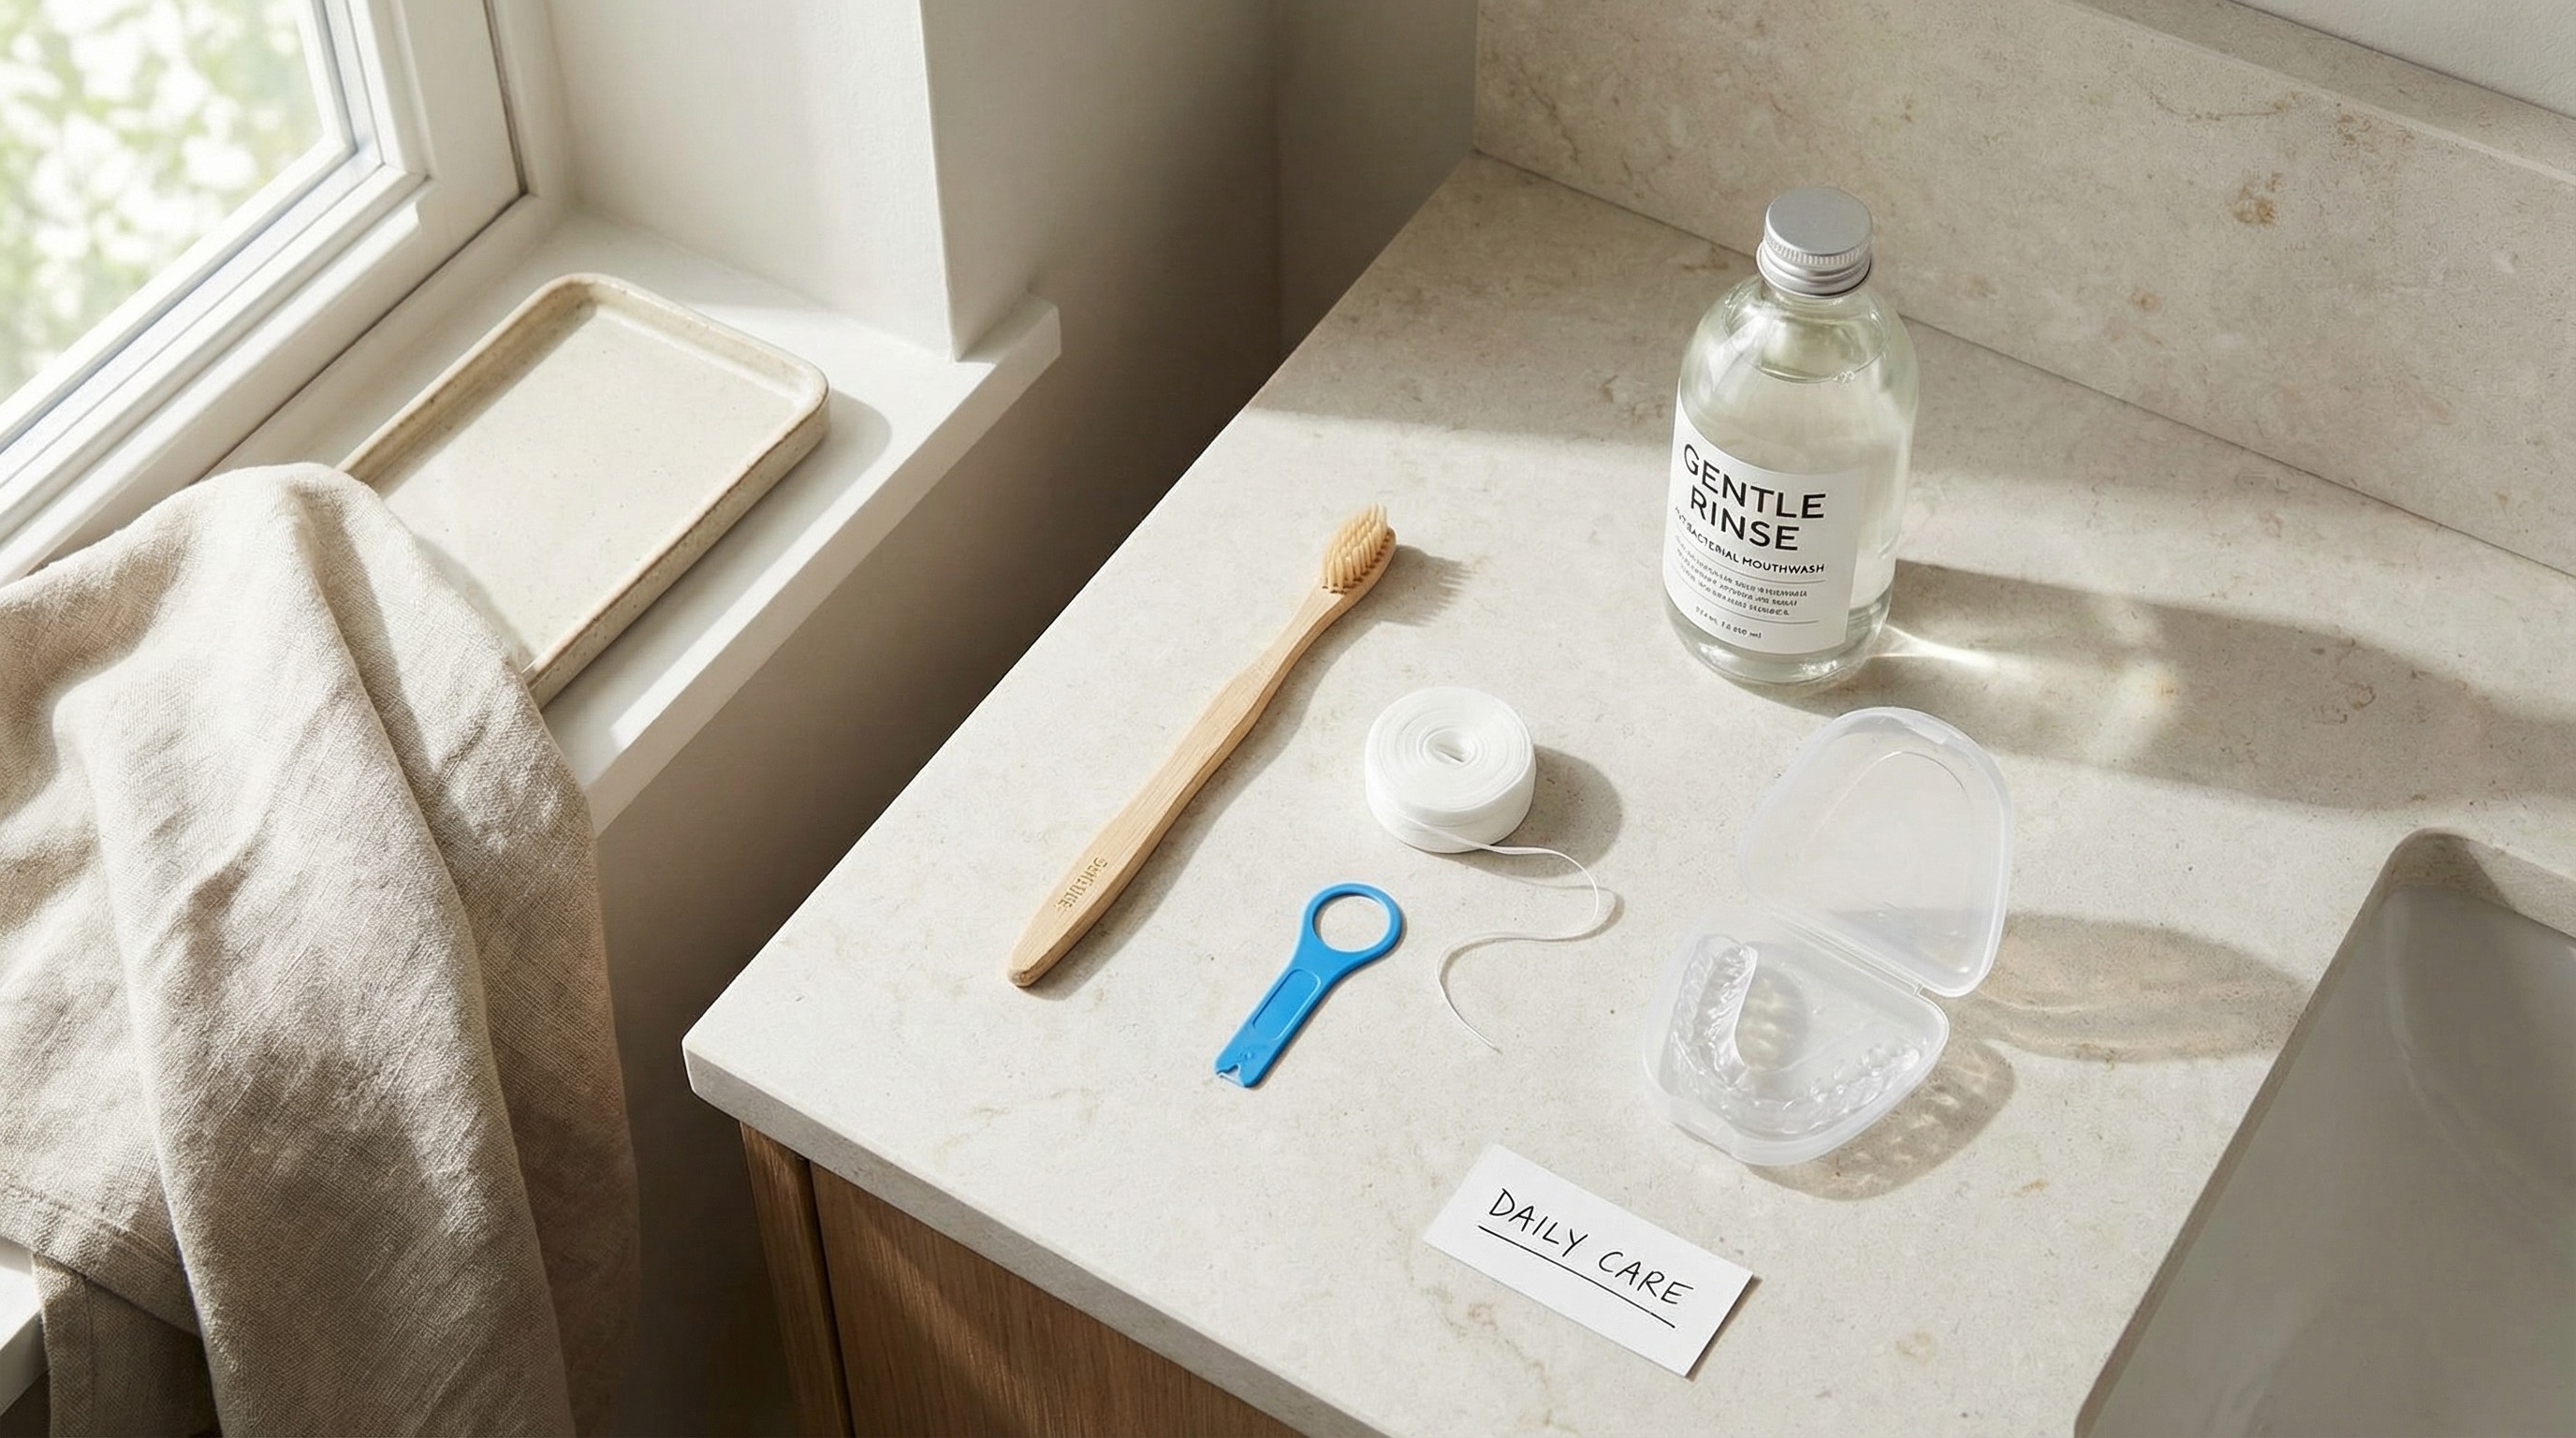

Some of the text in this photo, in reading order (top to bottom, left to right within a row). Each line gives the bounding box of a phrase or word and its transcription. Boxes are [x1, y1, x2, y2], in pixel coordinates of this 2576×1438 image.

[1684, 444, 1826, 520] GENTLE
[1690, 485, 1800, 551] RINSE
[1742, 556, 1826, 574] MOUTHWASH
[1488, 1188, 1694, 1305] DAILY CARE
